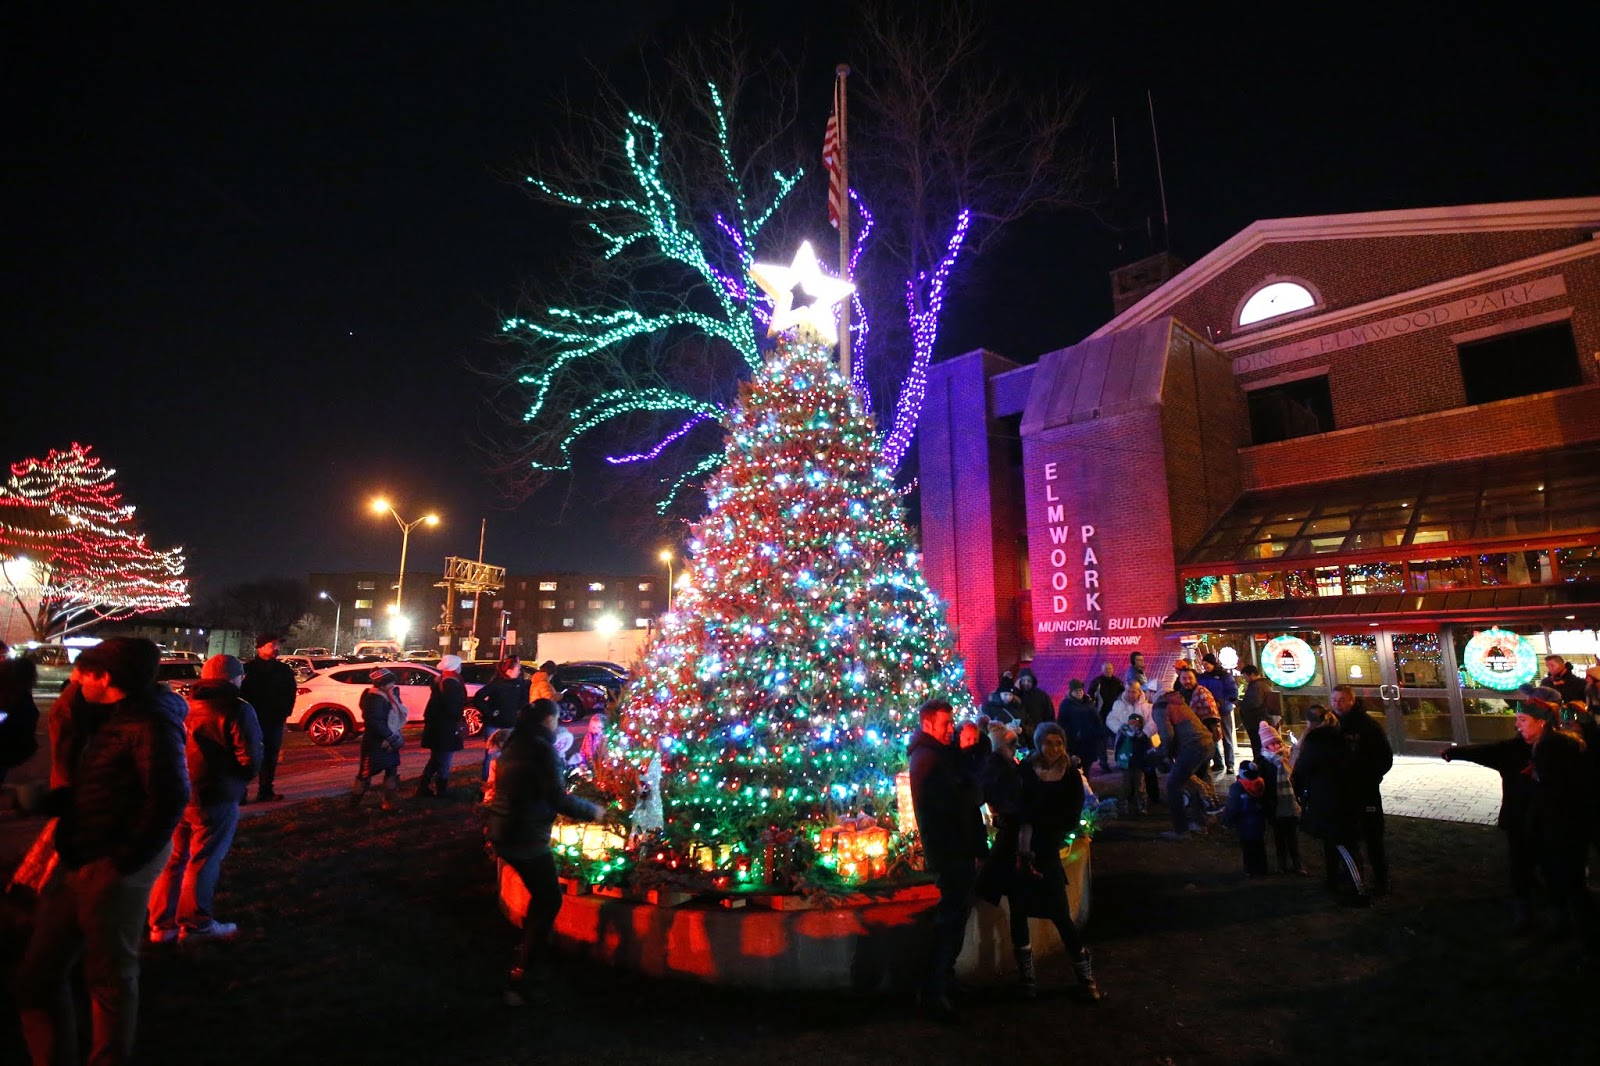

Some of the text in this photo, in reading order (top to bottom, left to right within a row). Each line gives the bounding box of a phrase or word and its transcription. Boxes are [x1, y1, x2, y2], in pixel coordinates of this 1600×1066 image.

[1319, 306, 1451, 352] ELMWOOD
[1463, 283, 1537, 316] PARK
[1045, 462, 1069, 613] ELMWOOD
[1081, 525, 1102, 612] PARK
[1038, 619, 1102, 633] MUNICIPAL
[1072, 637, 1099, 647] CONTI
[1099, 635, 1142, 646] PARKWAY
